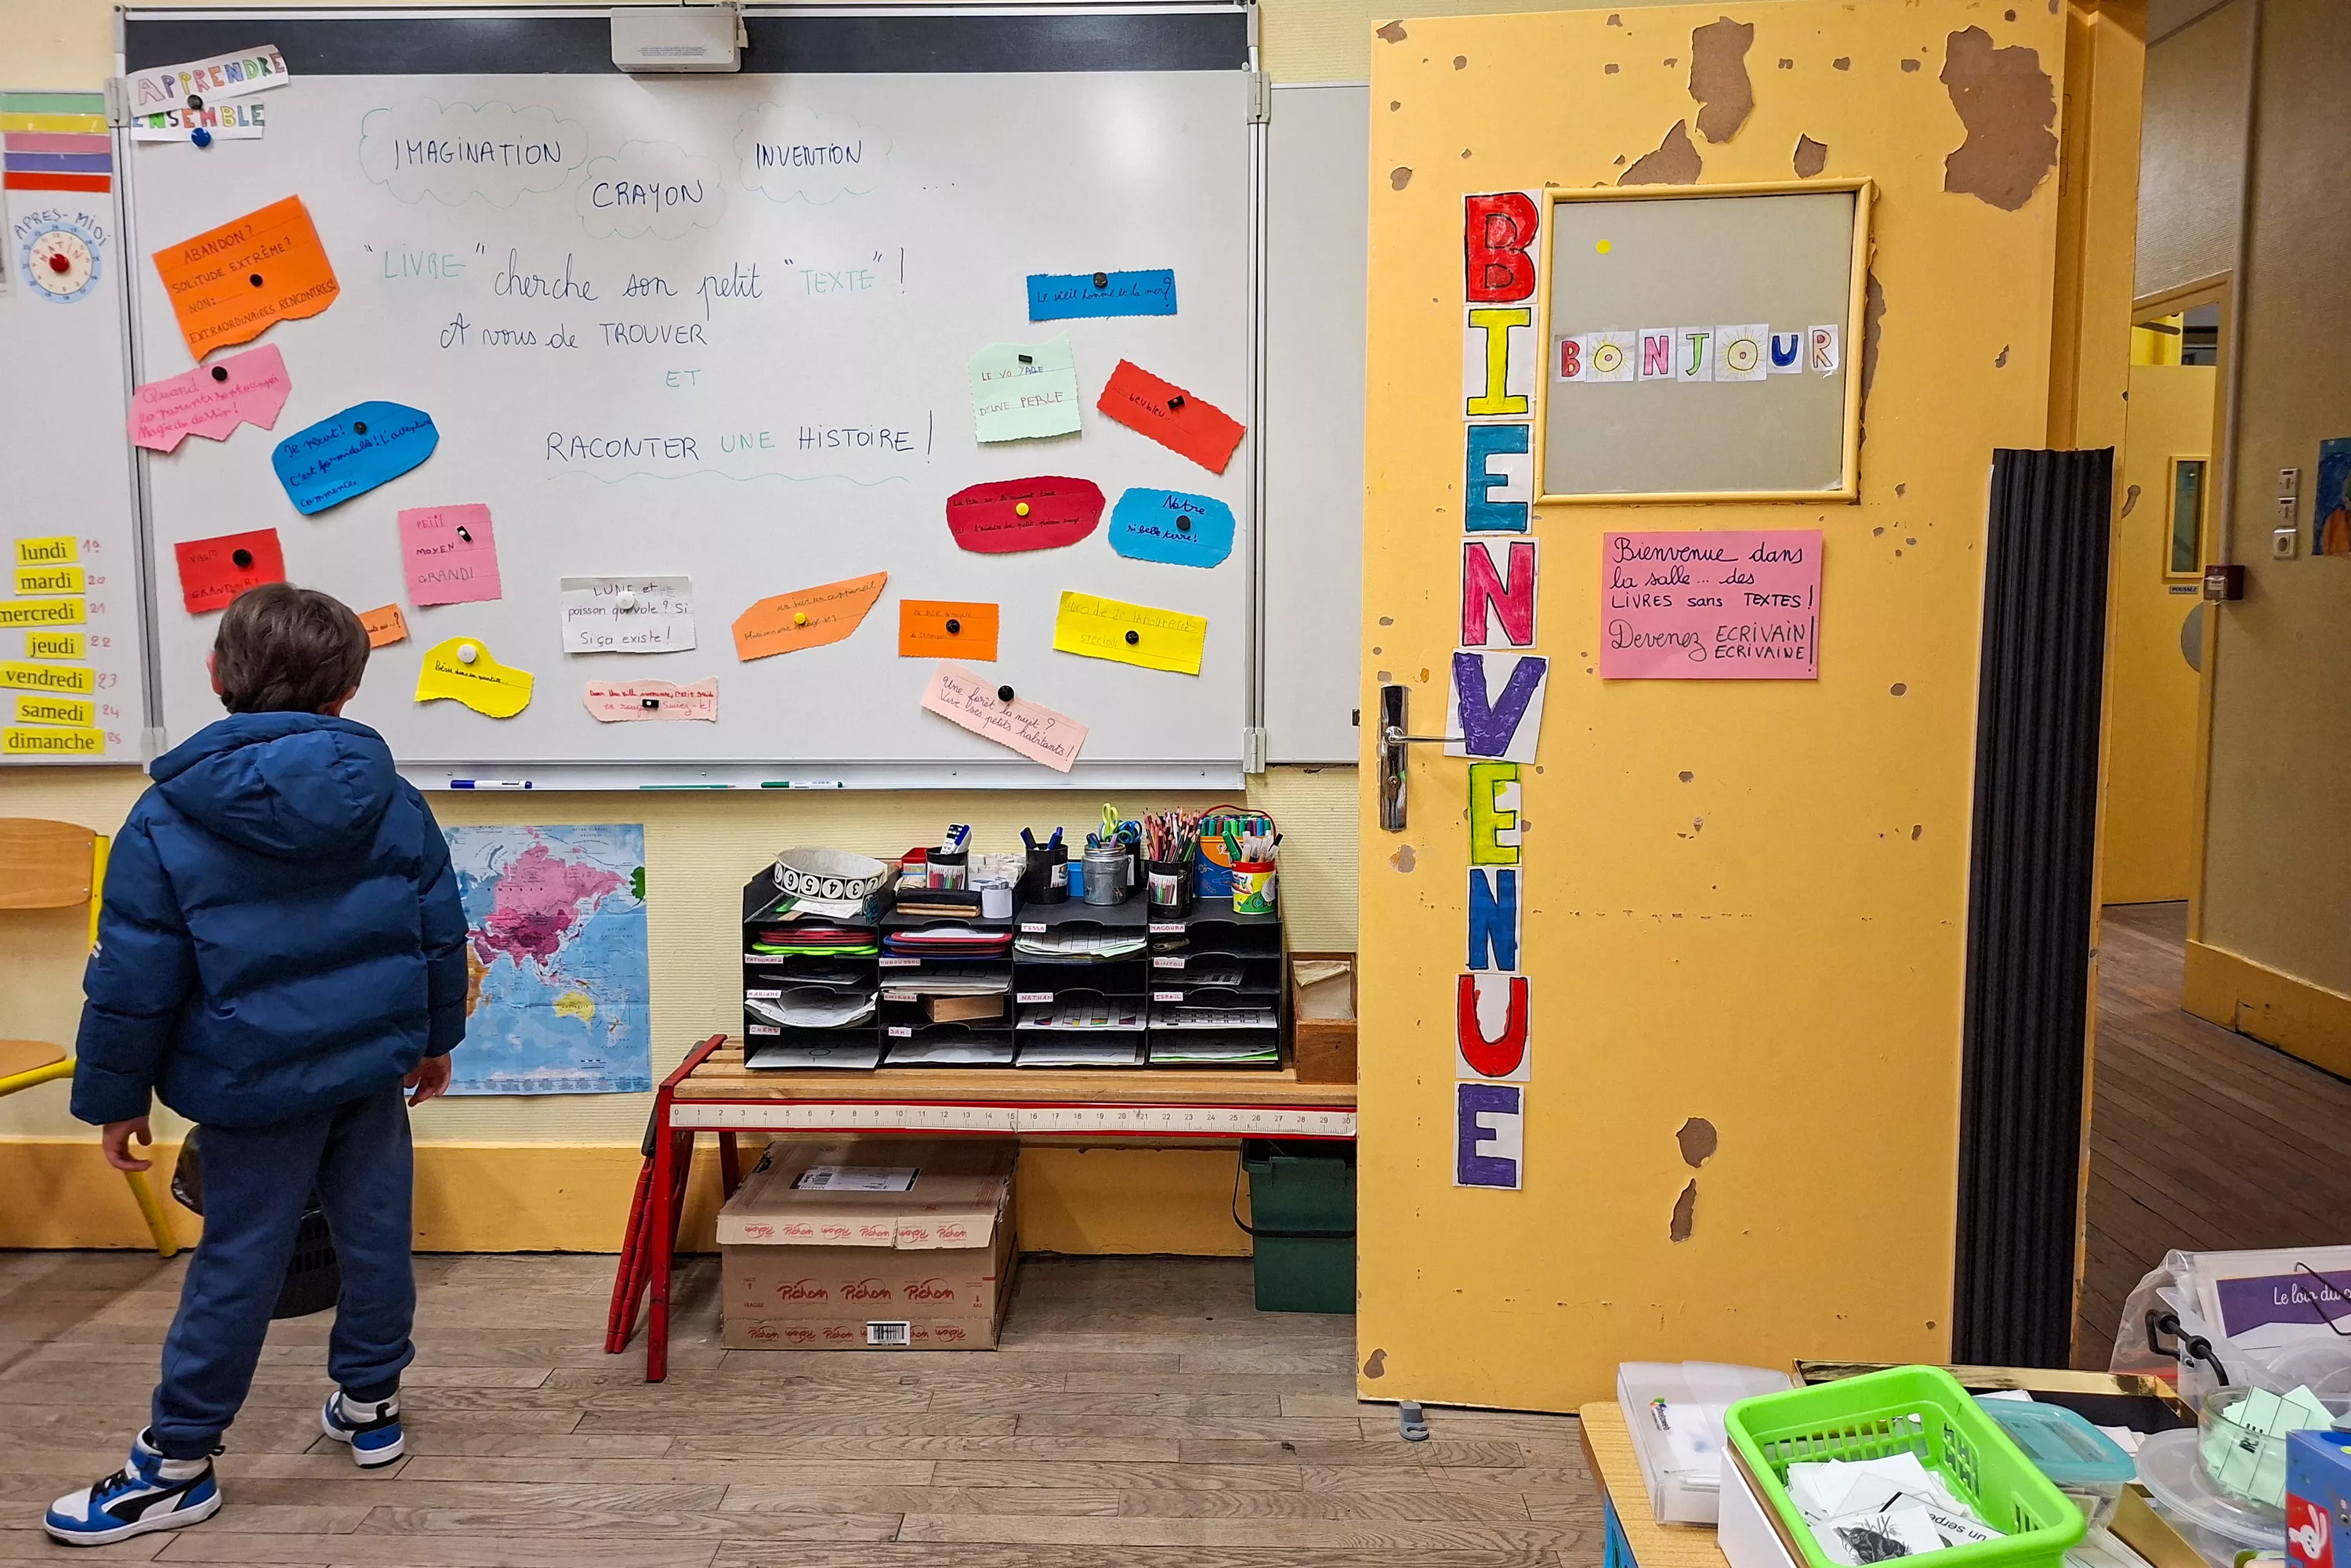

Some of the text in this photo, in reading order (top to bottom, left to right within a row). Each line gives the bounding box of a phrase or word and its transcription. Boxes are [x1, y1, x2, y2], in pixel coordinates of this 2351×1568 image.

[138, 53, 285, 106] APPRENDRE
[394, 136, 562, 170] IMAGINATION
[755, 139, 863, 170] INVENTION
[592, 179, 704, 213] CRAYON
[172, 268, 225, 294] SOLITUDE
[494, 247, 599, 301] cherche
[622, 273, 678, 297] son
[697, 261, 763, 321] petit
[1081, 288, 1114, 300] homme
[483, 328, 538, 346] vous
[545, 323, 579, 349] de
[599, 323, 707, 345] TROUVER
[1560, 328, 1833, 378] BONJOUR
[665, 369, 701, 388] ET
[982, 371, 991, 381] LE
[143, 376, 200, 404] Quand
[1020, 391, 1063, 408] PERLE
[156, 393, 214, 419] parents
[139, 423, 173, 440] Magie
[546, 424, 915, 462] RACONTER UNE HISTOIRE
[289, 465, 317, 487] C'est
[1163, 494, 1205, 515] Notre
[1137, 526, 1161, 537] belle
[21, 539, 102, 561] lundi 19
[416, 541, 455, 556] MOYEN
[1612, 537, 1803, 564] Bienvenue dans
[21, 571, 106, 589] mardi 20
[643, 581, 658, 593] et
[1609, 566, 1638, 589] la
[1718, 567, 1755, 585] des
[1611, 591, 1673, 609] LIVRES
[1687, 597, 1723, 608] sans
[0, 602, 106, 623] mercredi 21
[568, 607, 606, 623] poisson
[633, 602, 658, 614] vole
[675, 603, 688, 614] Si
[30, 636, 111, 657] jeudi 22
[580, 629, 662, 647] Si ça existe
[1608, 618, 1708, 662] Devenez
[5, 668, 117, 690] vendredi 23
[1451, 192, 1547, 1188] BIENVENUE
[21, 704, 120, 722] samedi 24
[940, 687, 961, 708] Vive
[983, 715, 1012, 729] petits
[943, 675, 1042, 730] Une forêt la nuit
[9, 732, 121, 750] dimanche 25
[777, 1278, 955, 1301] Pichon Pichon Pichon
[2273, 1286, 2289, 1305] Le
[2320, 1284, 2342, 1301] du
[1929, 1512, 1987, 1541] un serpe
